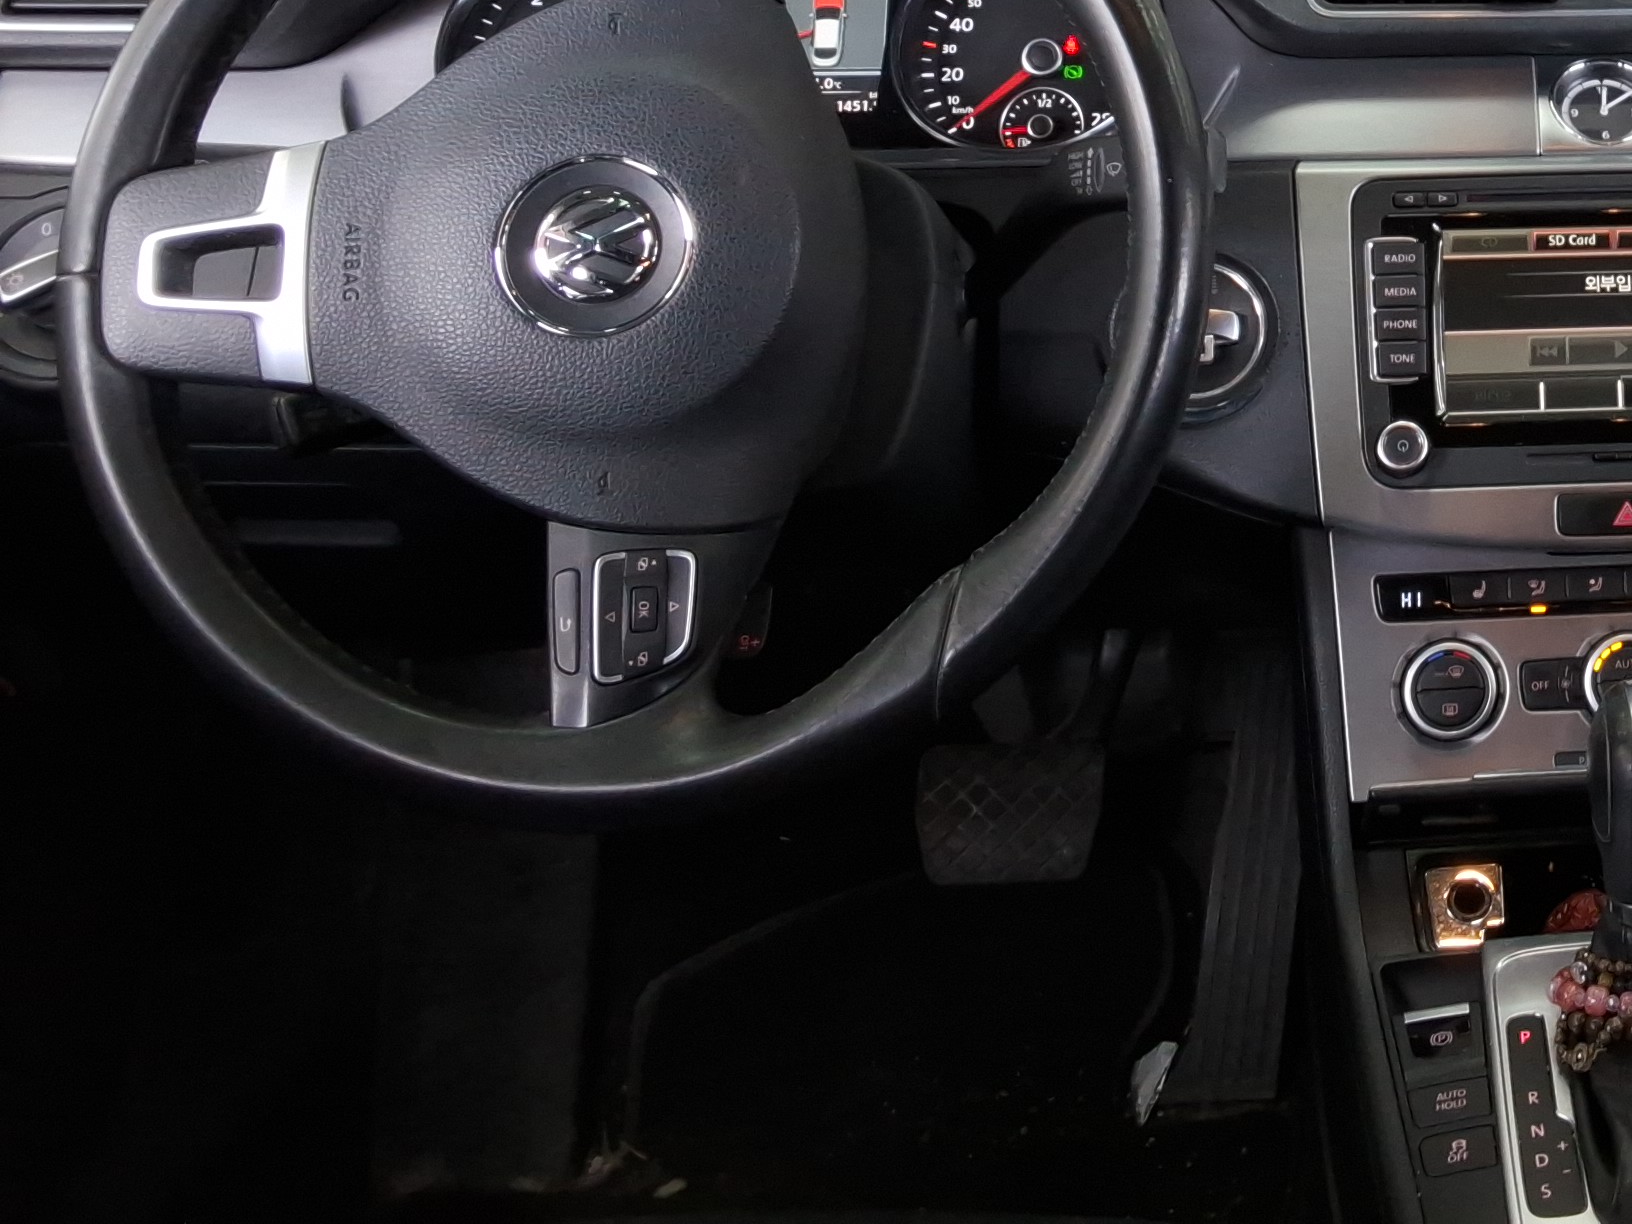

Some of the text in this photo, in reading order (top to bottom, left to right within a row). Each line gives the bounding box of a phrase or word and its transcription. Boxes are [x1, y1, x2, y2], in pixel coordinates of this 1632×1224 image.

[949, 18, 974, 32] 40
[941, 44, 957, 54] 30
[941, 67, 964, 81] 20
[837, 100, 877, 112] 1451.
[947, 96, 960, 105] 10
[1037, 99, 1052, 108] 1/2
[1481, 236, 1498, 248] CD
[1548, 234, 1596, 246] SD Card
[343, 222, 362, 302] AIRBAG
[1384, 254, 1416, 263] RADIO
[1384, 287, 1417, 297] MEDIA
[1383, 319, 1418, 329] PHONE
[1390, 354, 1416, 363] TONE
[638, 600, 650, 619] OK
[1531, 681, 1549, 691] OFF
[1519, 1030, 1531, 1045] P
[1436, 1089, 1467, 1102] AUTO
[1528, 1091, 1539, 1105] R
[1435, 1098, 1467, 1111] HOLD
[1531, 1124, 1545, 1138] N
[1447, 1151, 1469, 1163] OFF
[1535, 1153, 1549, 1167] D
[1541, 1184, 1552, 1199] S
